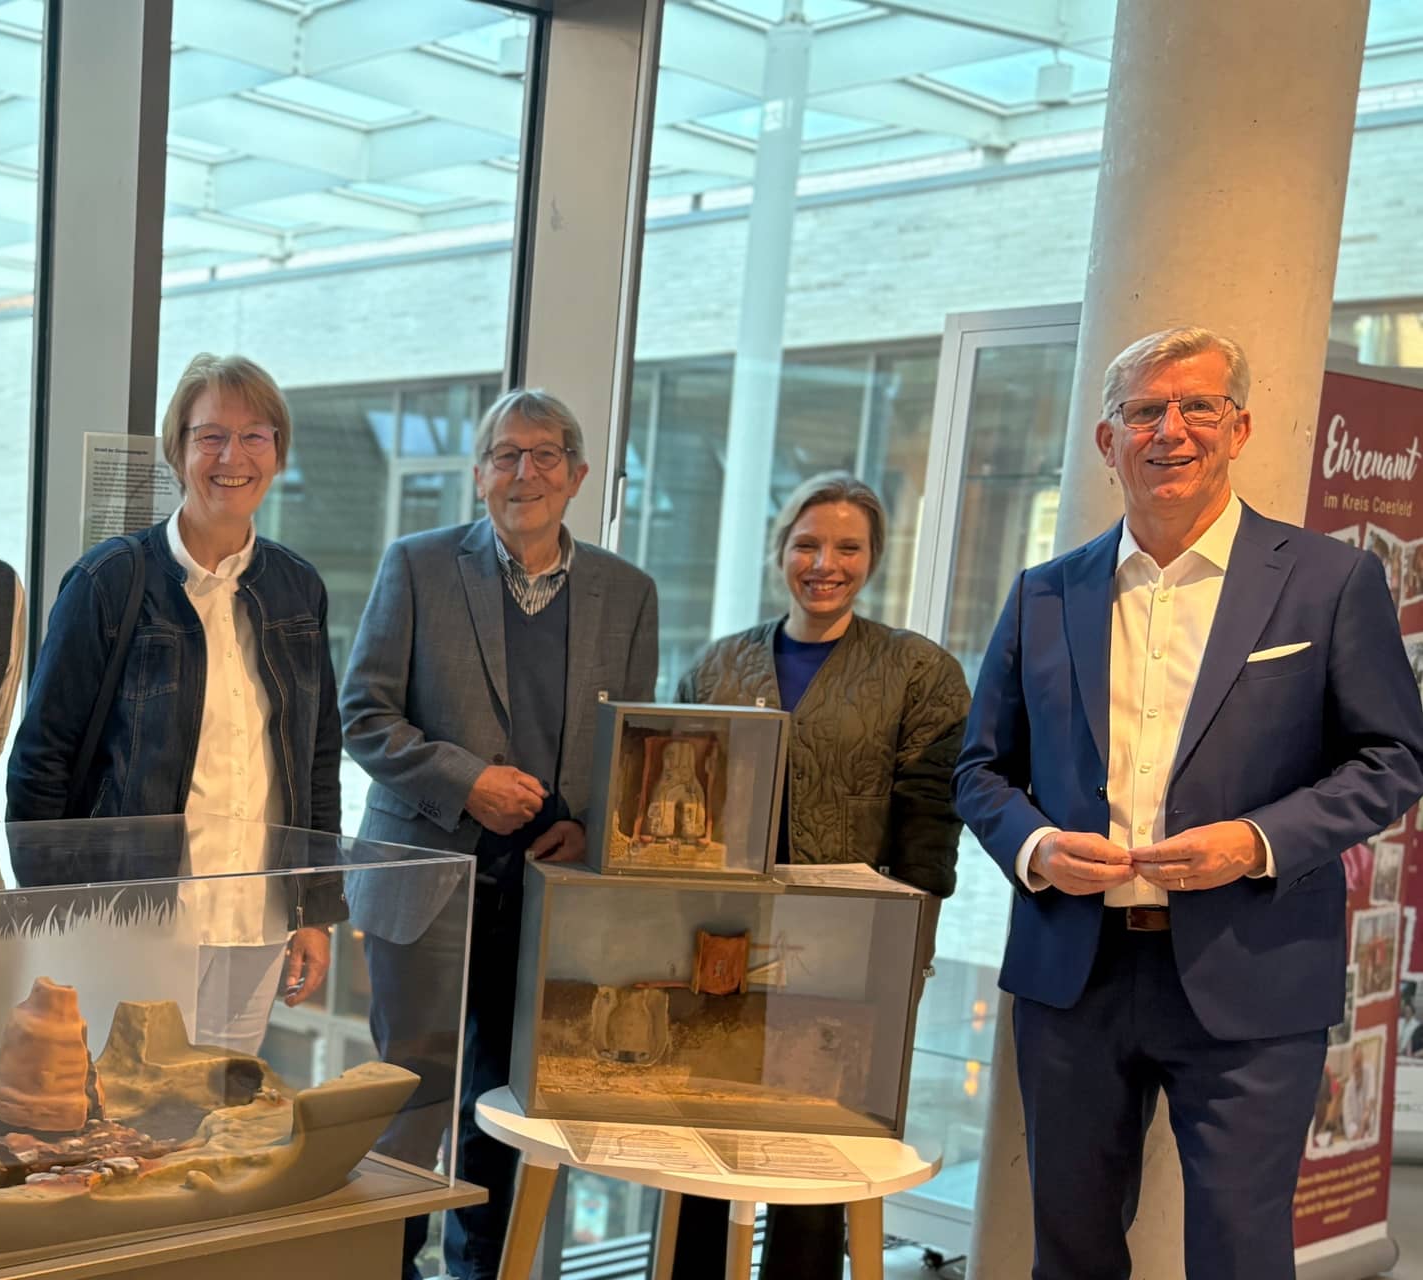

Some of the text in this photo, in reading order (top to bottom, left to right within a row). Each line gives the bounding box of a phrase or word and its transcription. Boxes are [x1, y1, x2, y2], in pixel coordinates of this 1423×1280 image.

[1323, 413, 1422, 482] Ehrenamt
[1324, 490, 1413, 518] im Kreis Coesfeld
